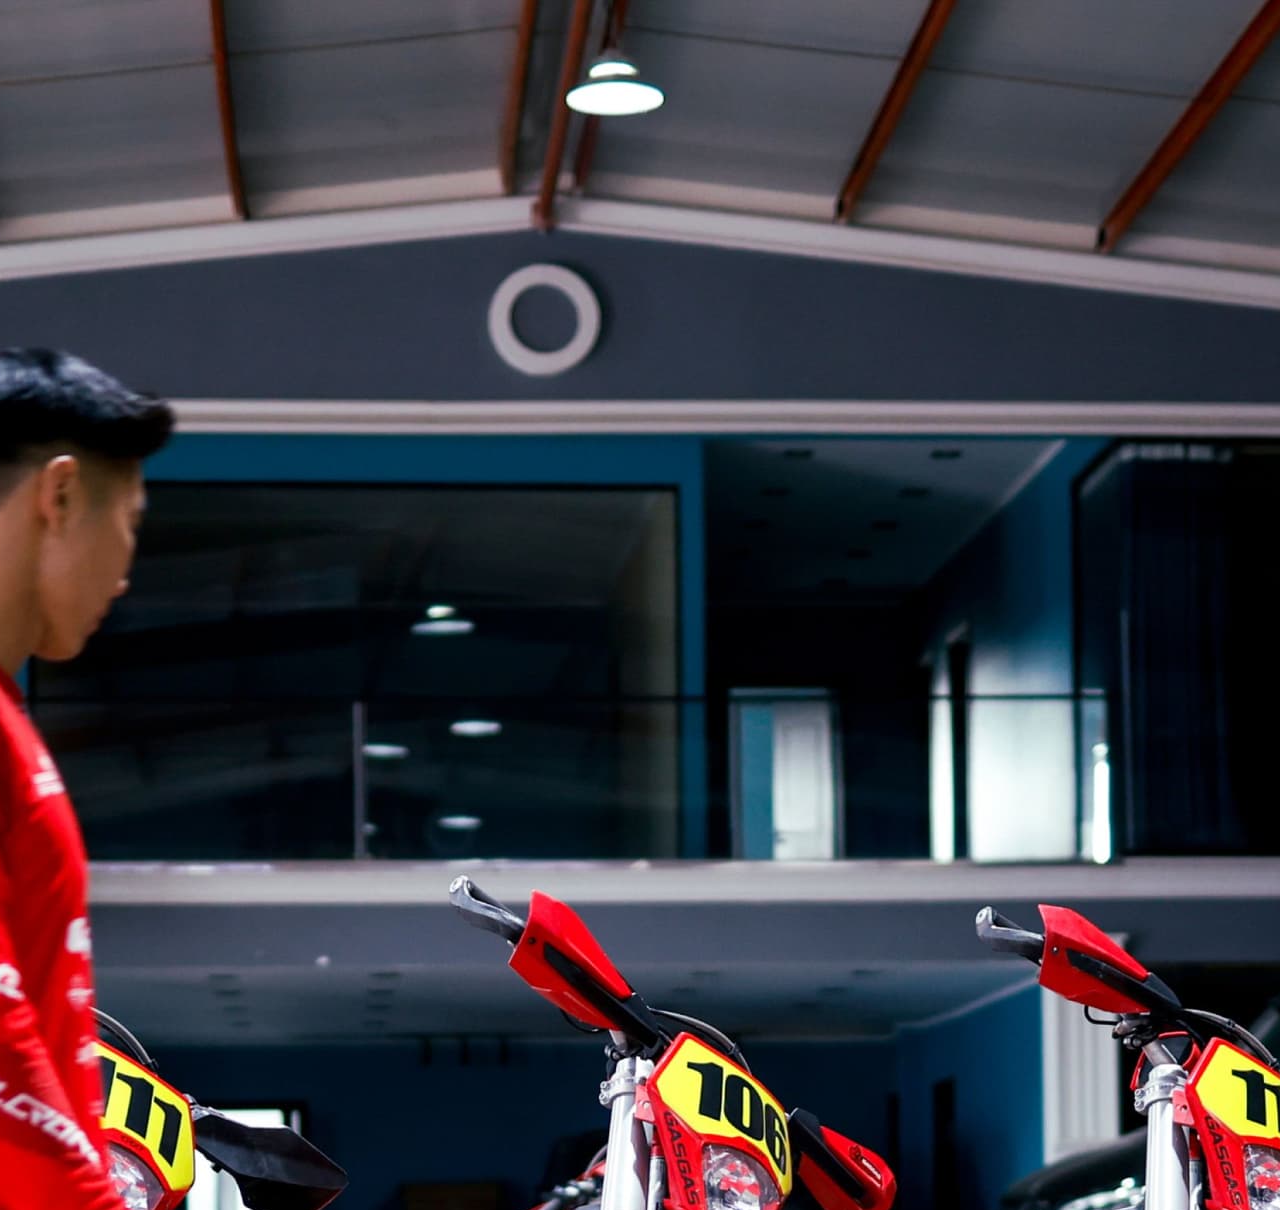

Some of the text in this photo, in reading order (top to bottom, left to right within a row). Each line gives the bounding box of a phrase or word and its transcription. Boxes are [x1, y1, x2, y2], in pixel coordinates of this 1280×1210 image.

[663, 1111, 700, 1206] GASGAS
[687, 1061, 787, 1175] 106
[1205, 1114, 1245, 1207] GASGAS
